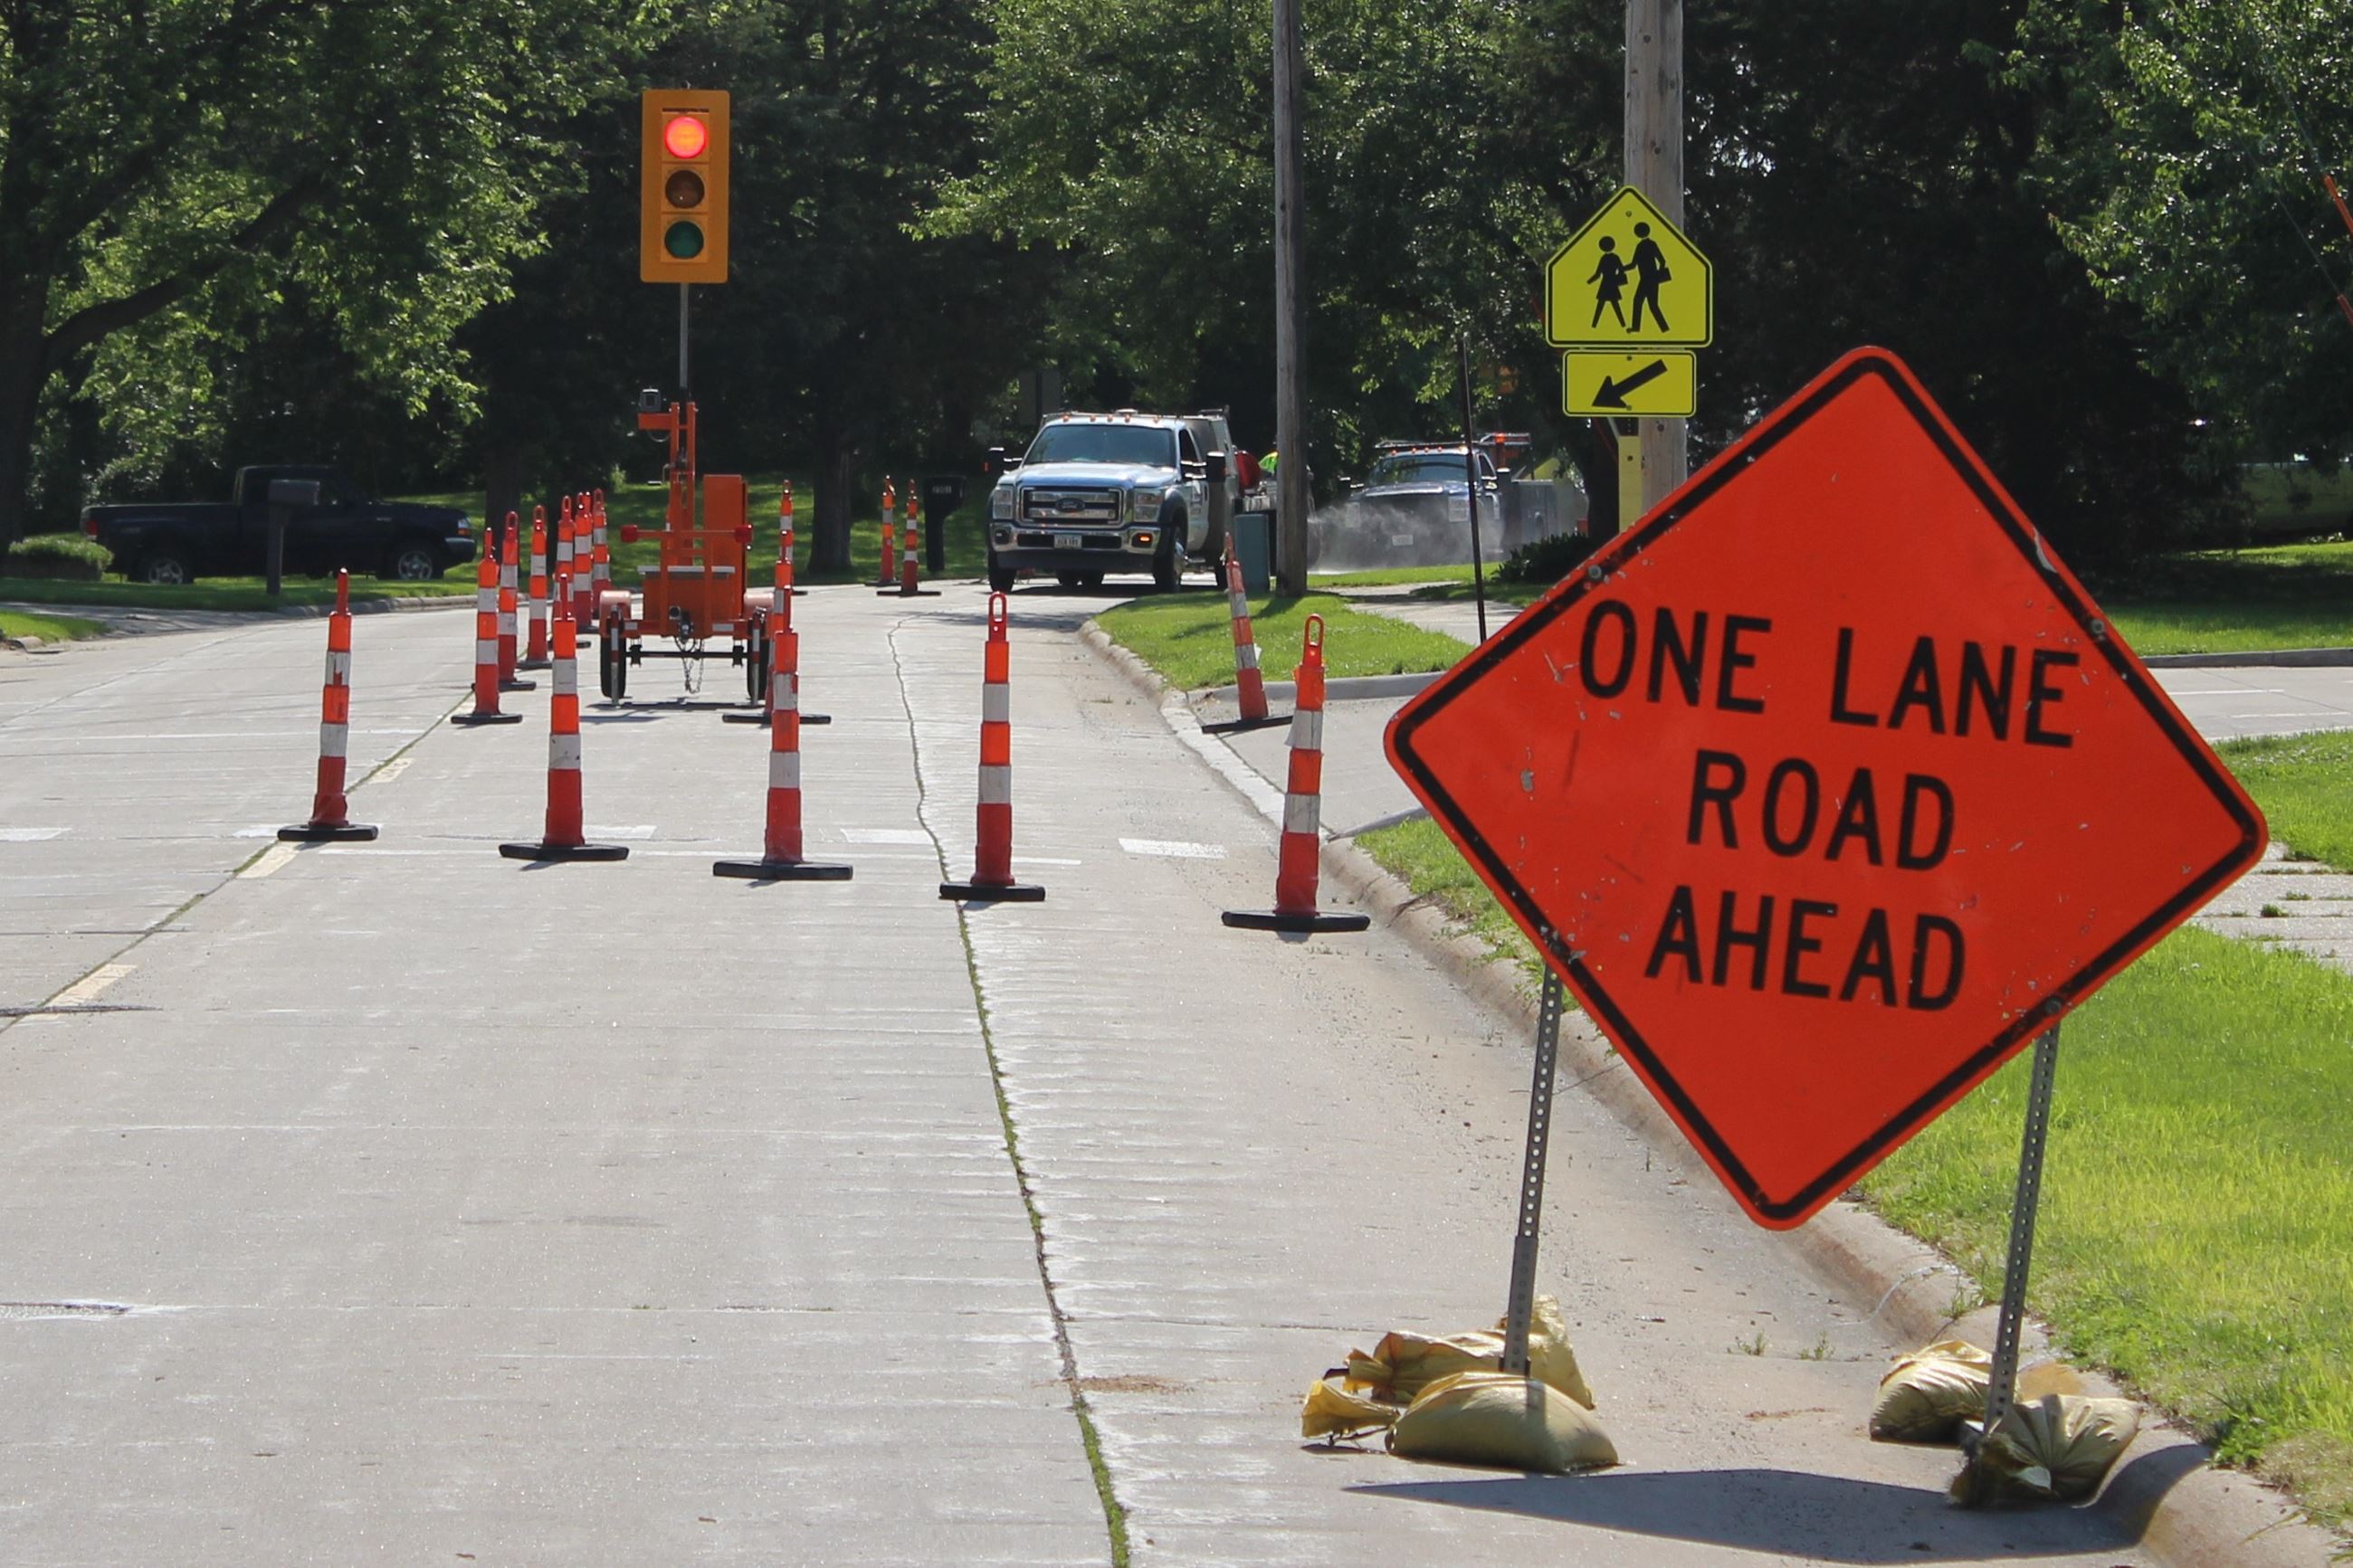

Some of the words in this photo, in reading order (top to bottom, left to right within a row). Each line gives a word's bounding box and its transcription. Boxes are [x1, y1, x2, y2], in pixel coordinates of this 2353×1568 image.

[1578, 599, 1772, 715] ONE
[1830, 627, 2081, 748] LANE
[1687, 748, 1955, 871] ROAD
[1644, 885, 1966, 1012] AHEAD
